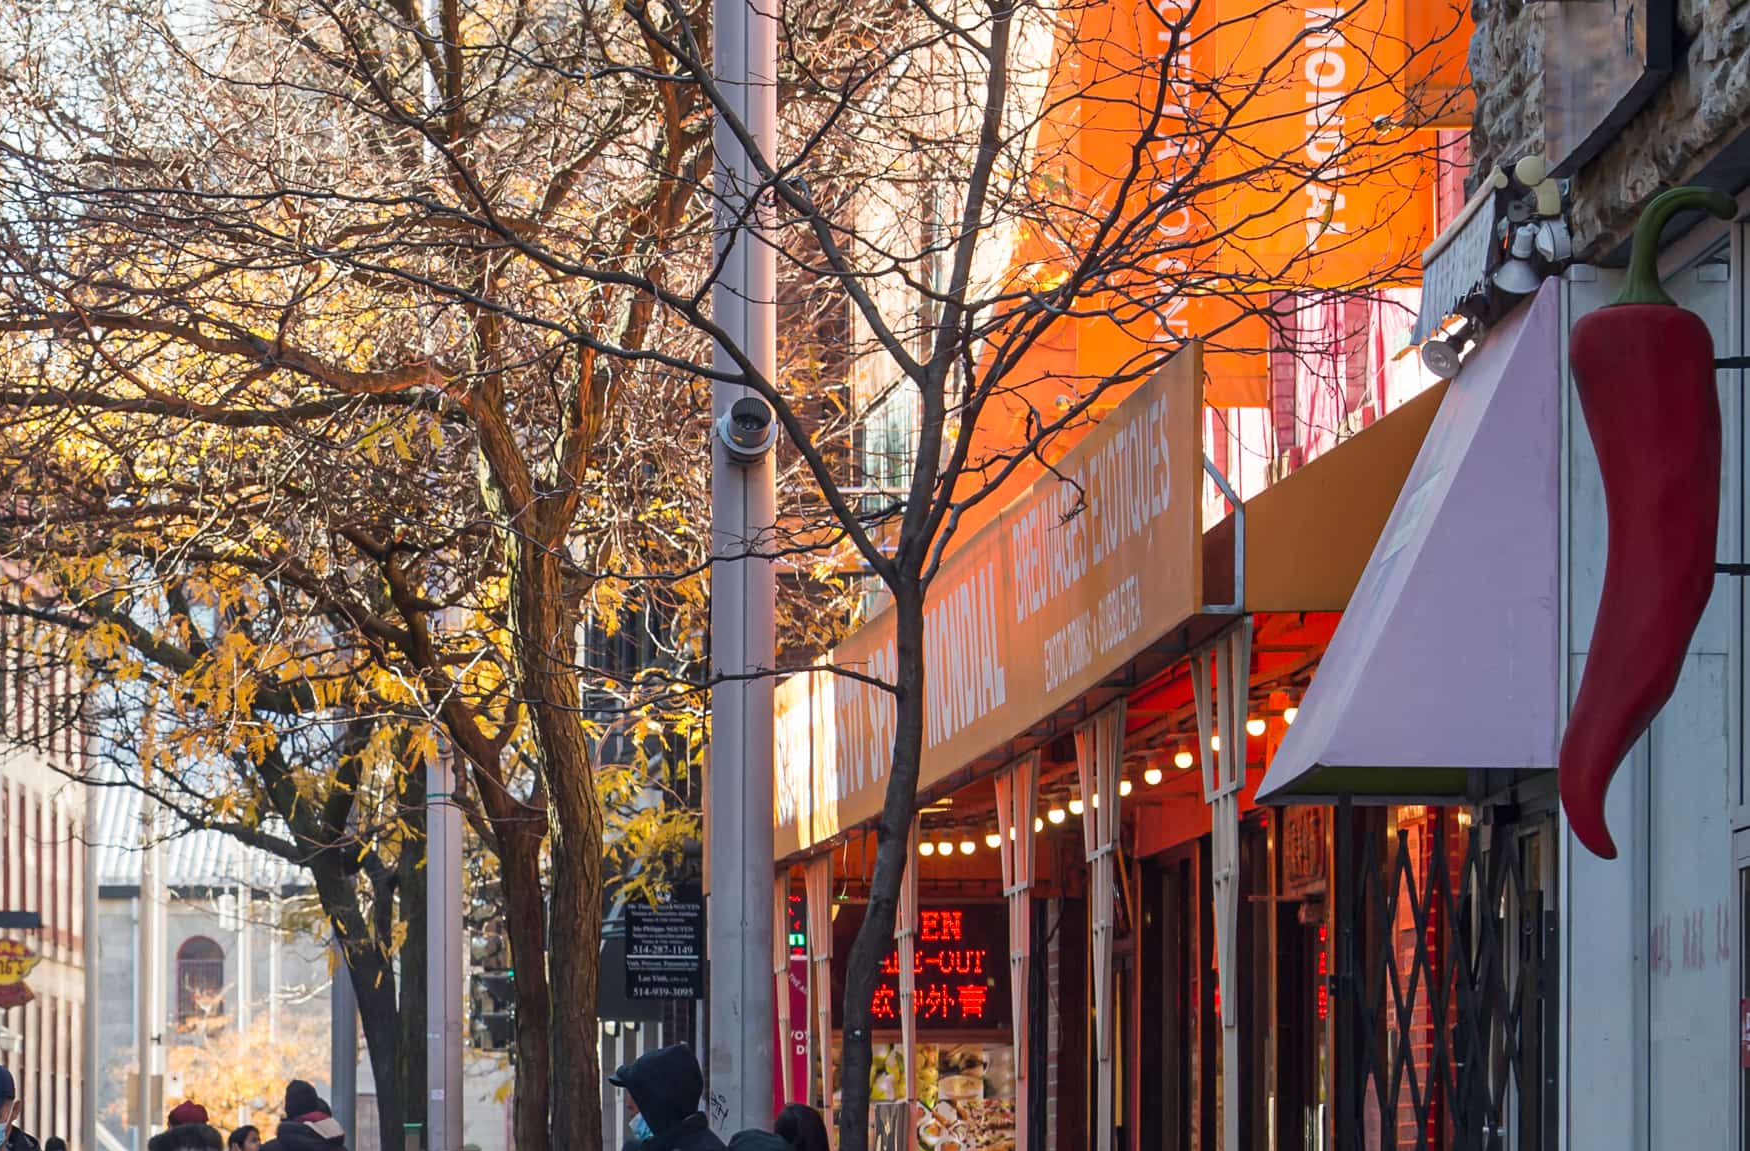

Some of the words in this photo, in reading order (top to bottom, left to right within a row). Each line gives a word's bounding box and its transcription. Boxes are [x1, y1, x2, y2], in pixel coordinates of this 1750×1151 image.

[1305, 8, 1347, 252] MONDIAL
[1012, 465, 1087, 624] BREUVAGES
[1090, 391, 1171, 566] EXOTIQUES
[923, 561, 1007, 749] MONDIAL
